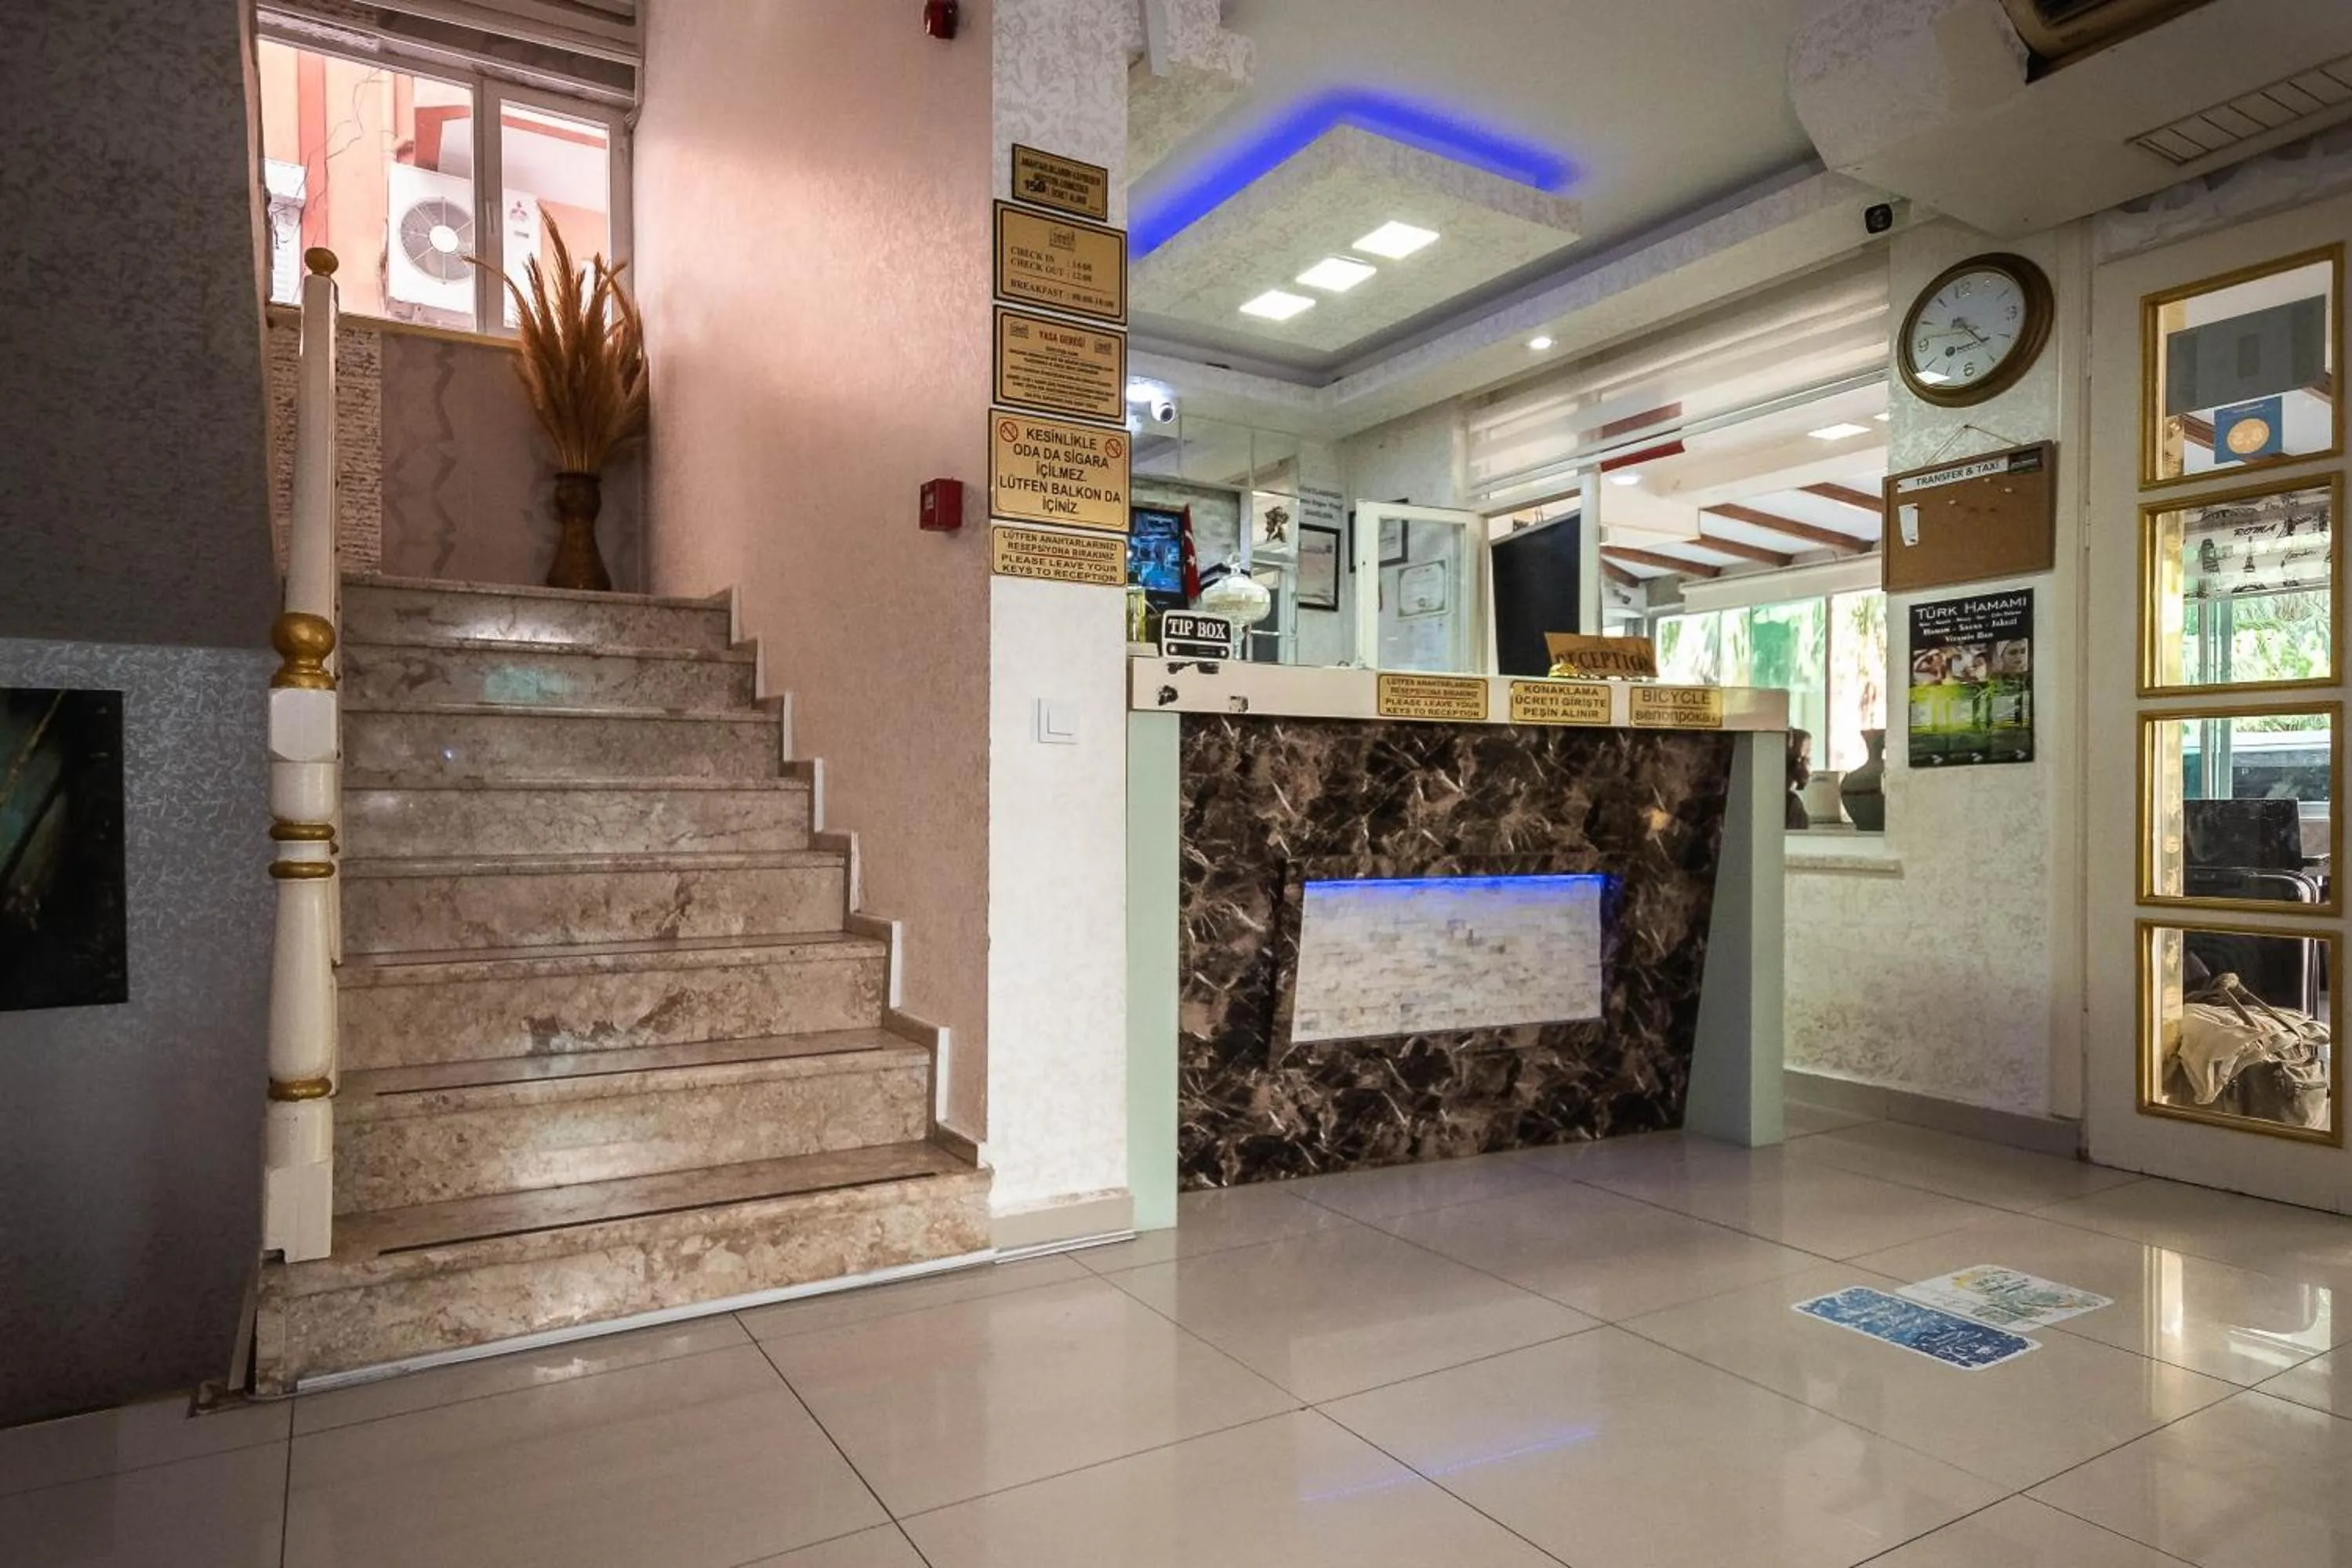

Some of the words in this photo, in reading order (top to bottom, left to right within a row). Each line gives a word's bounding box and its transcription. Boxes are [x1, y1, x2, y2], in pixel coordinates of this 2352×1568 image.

[1011, 246, 1043, 261] CHECK
[1011, 257, 1042, 271] CHECK
[1045, 266, 1064, 276] OUT
[1011, 278, 1064, 298] BREAKFAST
[1026, 427, 1097, 450] KESİNLİKLE
[1013, 444, 1040, 458] ODA
[1044, 448, 1061, 462] DA
[1064, 448, 1109, 468] SİGARA
[1915, 470, 1963, 486] TRANSFER
[1965, 467, 1974, 476] &
[1976, 463, 2000, 474] TAXI
[1000, 474, 1048, 493] LÜTFEN
[1051, 482, 1102, 501] BALKON
[1105, 491, 1121, 503] DA
[1003, 530, 1037, 541] LÜTFEN
[1001, 554, 1047, 565] PLEASE
[1049, 559, 1083, 569] LEAVE
[1087, 563, 1117, 572] YOUR
[1002, 564, 1033, 574] KEYS
[1036, 568, 1051, 576] TO
[1054, 569, 1117, 582] RECEPTION
[1915, 605, 1958, 620] TÜRK
[1964, 597, 2027, 614] HAMAMI
[1197, 621, 1226, 639] BOX
[1523, 684, 1599, 695] KONAKLAMA
[1642, 689, 1711, 705] BICYCLE
[1385, 698, 1421, 706] PLEASE
[1428, 708, 1480, 717] RECEPTION
